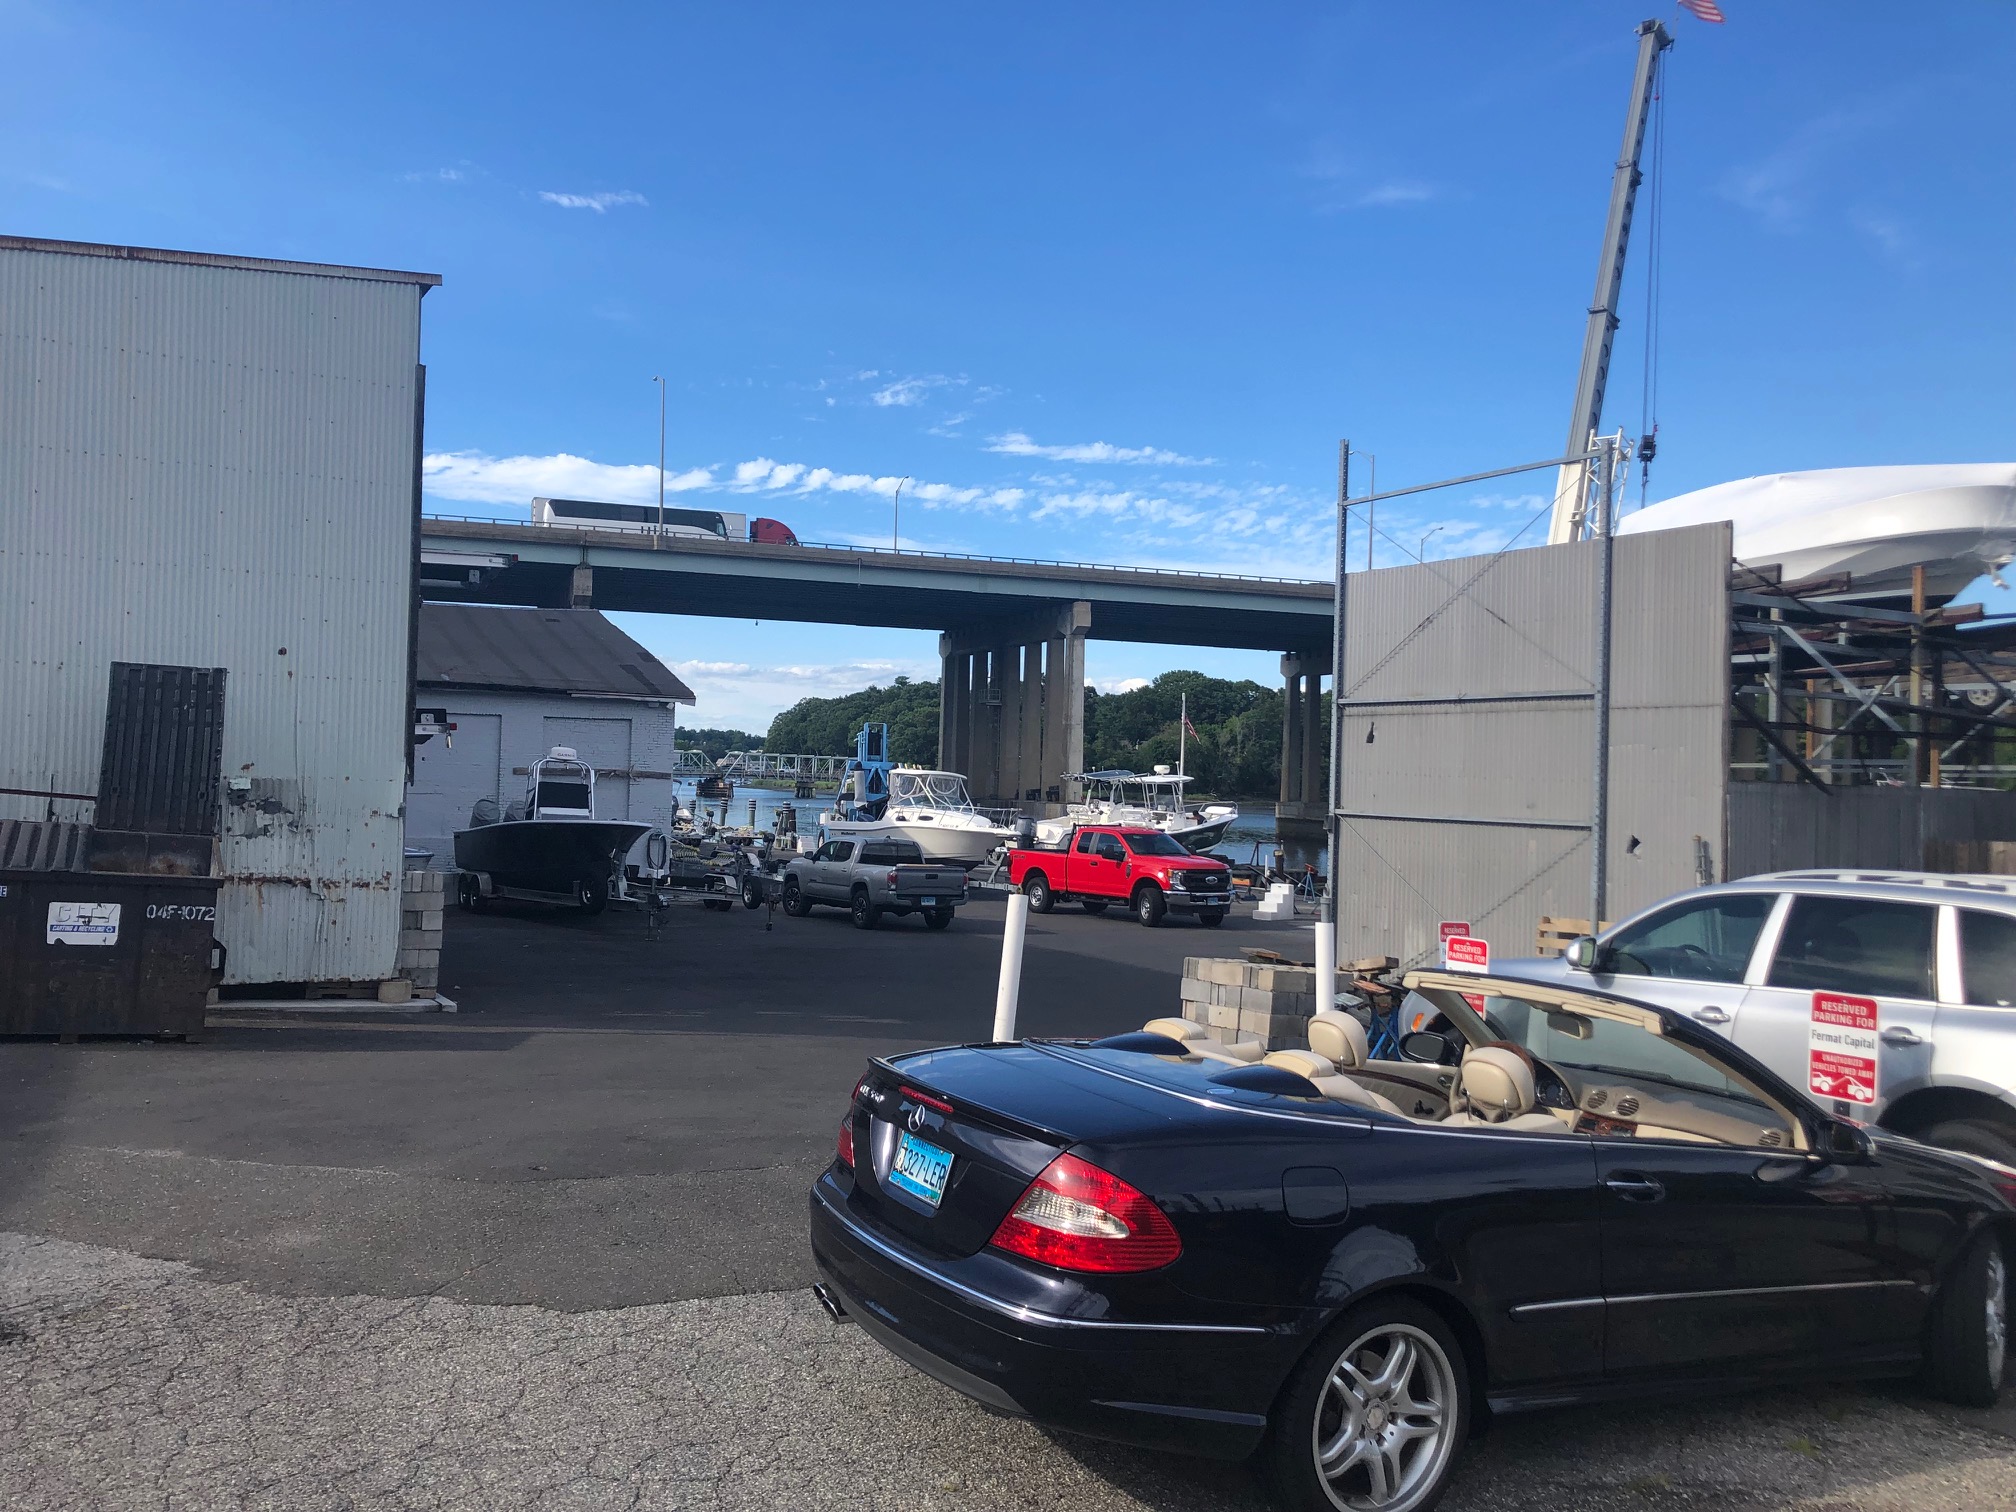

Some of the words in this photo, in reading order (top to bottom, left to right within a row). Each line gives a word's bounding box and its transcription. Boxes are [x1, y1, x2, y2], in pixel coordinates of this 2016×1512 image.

[55, 904, 117, 923] CITY
[1448, 951, 1473, 961] PARKING
[1473, 955, 1486, 963] FOR
[1453, 944, 1483, 955] RESERVED
[1821, 1000, 1867, 1016] RESERVED
[1814, 1010, 1853, 1025] PARKING
[1856, 1016, 1874, 1028] FOR
[1811, 1029, 1842, 1044] Fermat
[1844, 1034, 1875, 1049] Capital
[1822, 1053, 1864, 1067] UNAUTHORIZED
[1812, 1062, 1837, 1073] VEHICLES
[1837, 1065, 1857, 1076] TOWED
[1858, 1070, 1873, 1080] AWAY
